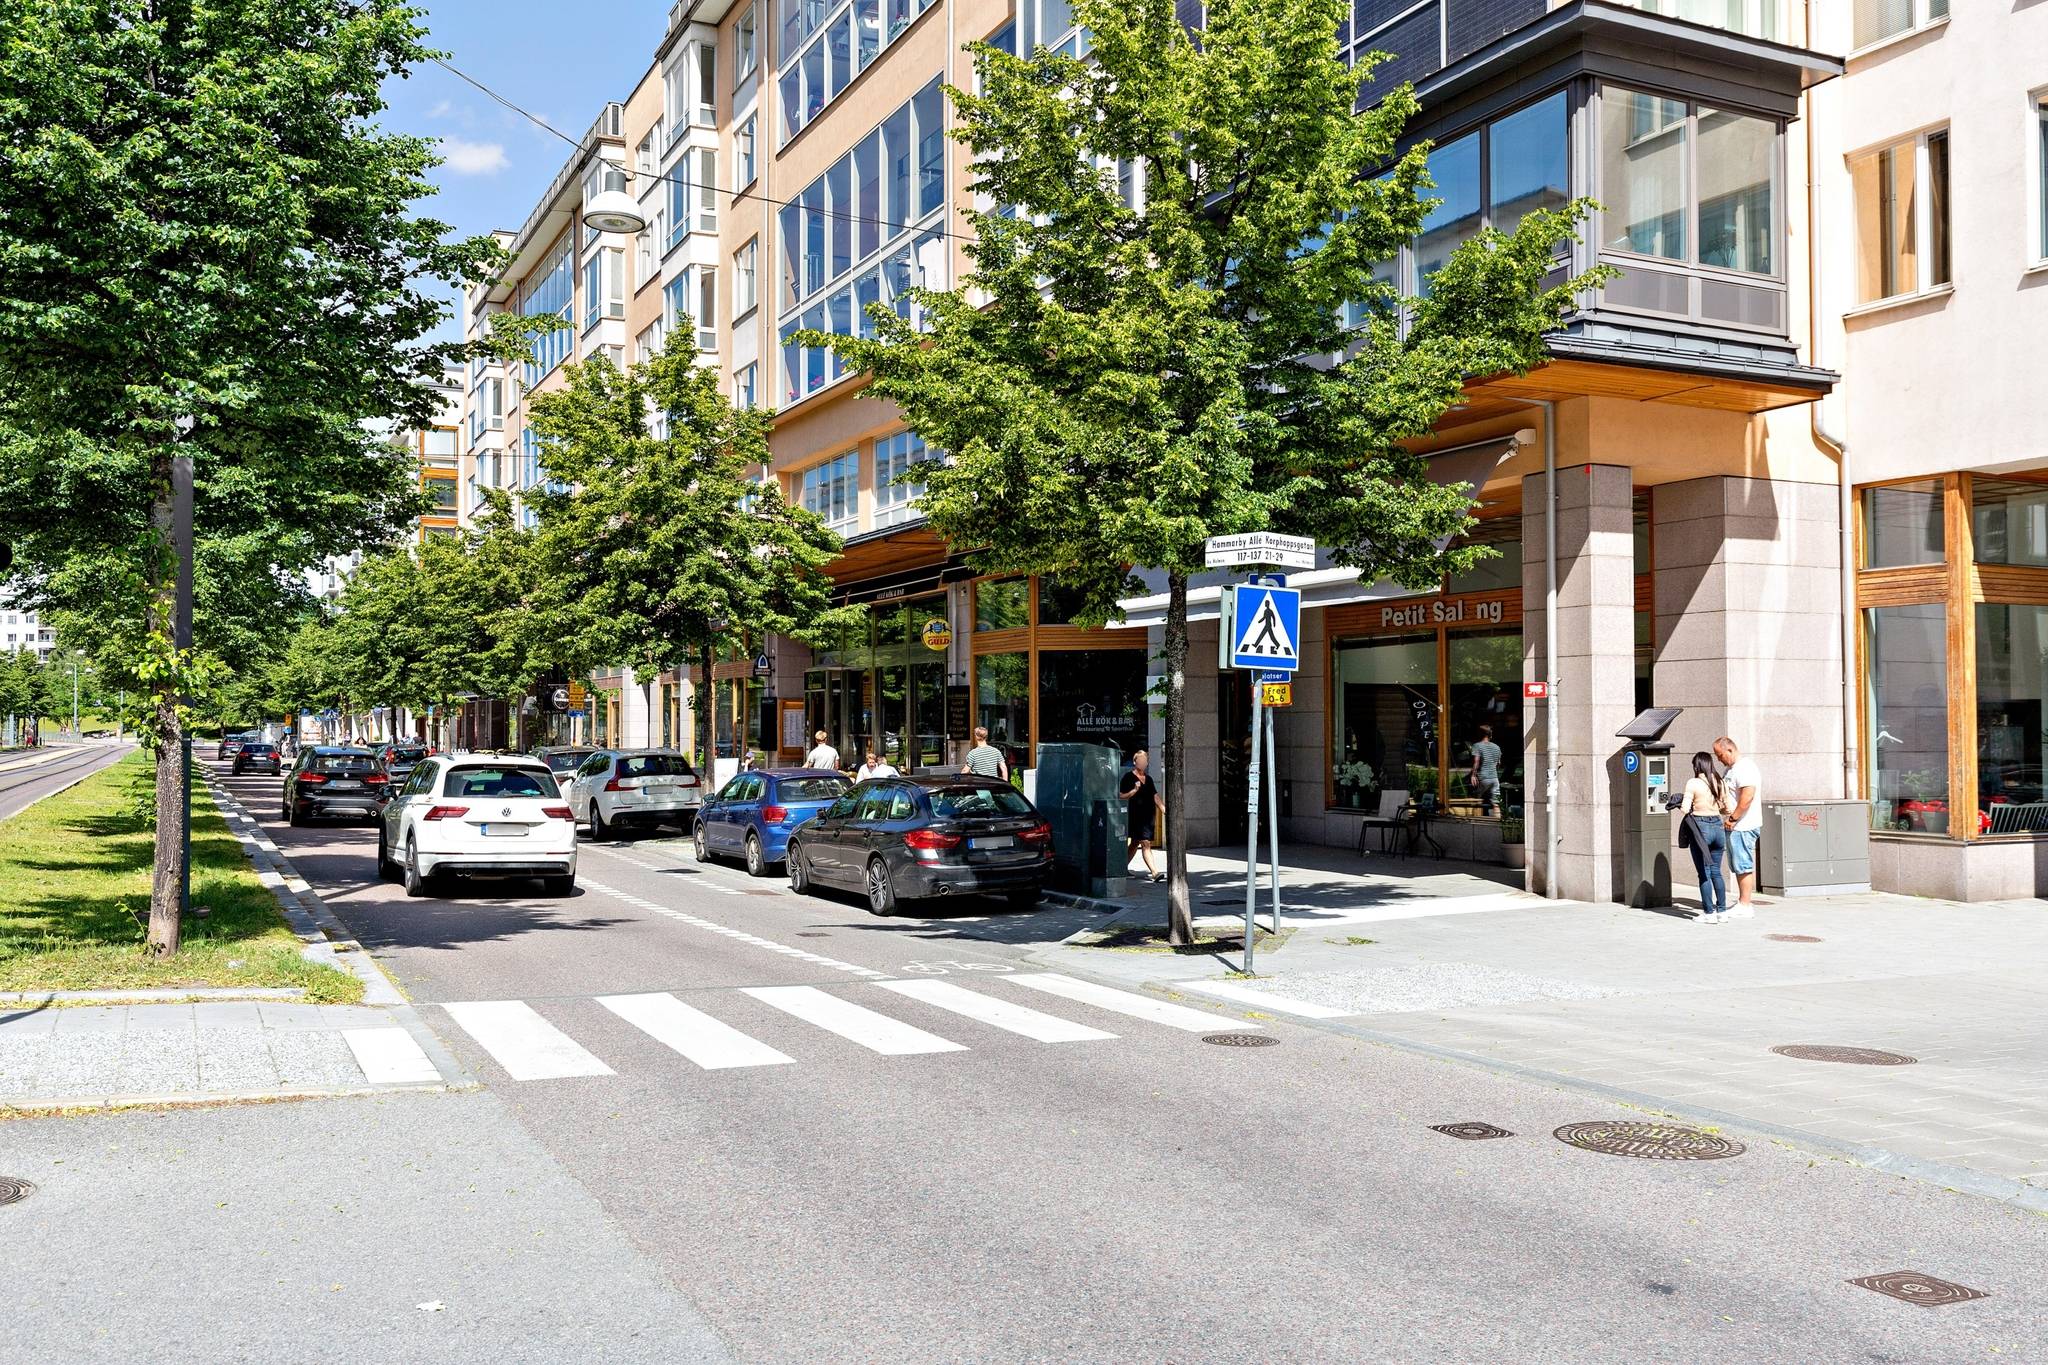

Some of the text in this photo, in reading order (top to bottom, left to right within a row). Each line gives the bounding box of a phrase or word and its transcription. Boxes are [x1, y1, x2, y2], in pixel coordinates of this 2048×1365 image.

[1212, 534, 1262, 549] Hammarby Allé
[1237, 551, 1262, 561] 117-137
[1265, 551, 1284, 561] 21-29
[1381, 604, 1425, 627] Petit
[927, 637, 950, 645] GULD
[1268, 686, 1286, 695] Fred
[1268, 695, 1285, 703] 0-6
[1096, 715, 1111, 725] KÖK
[1413, 699, 1433, 749] ÖPPET
